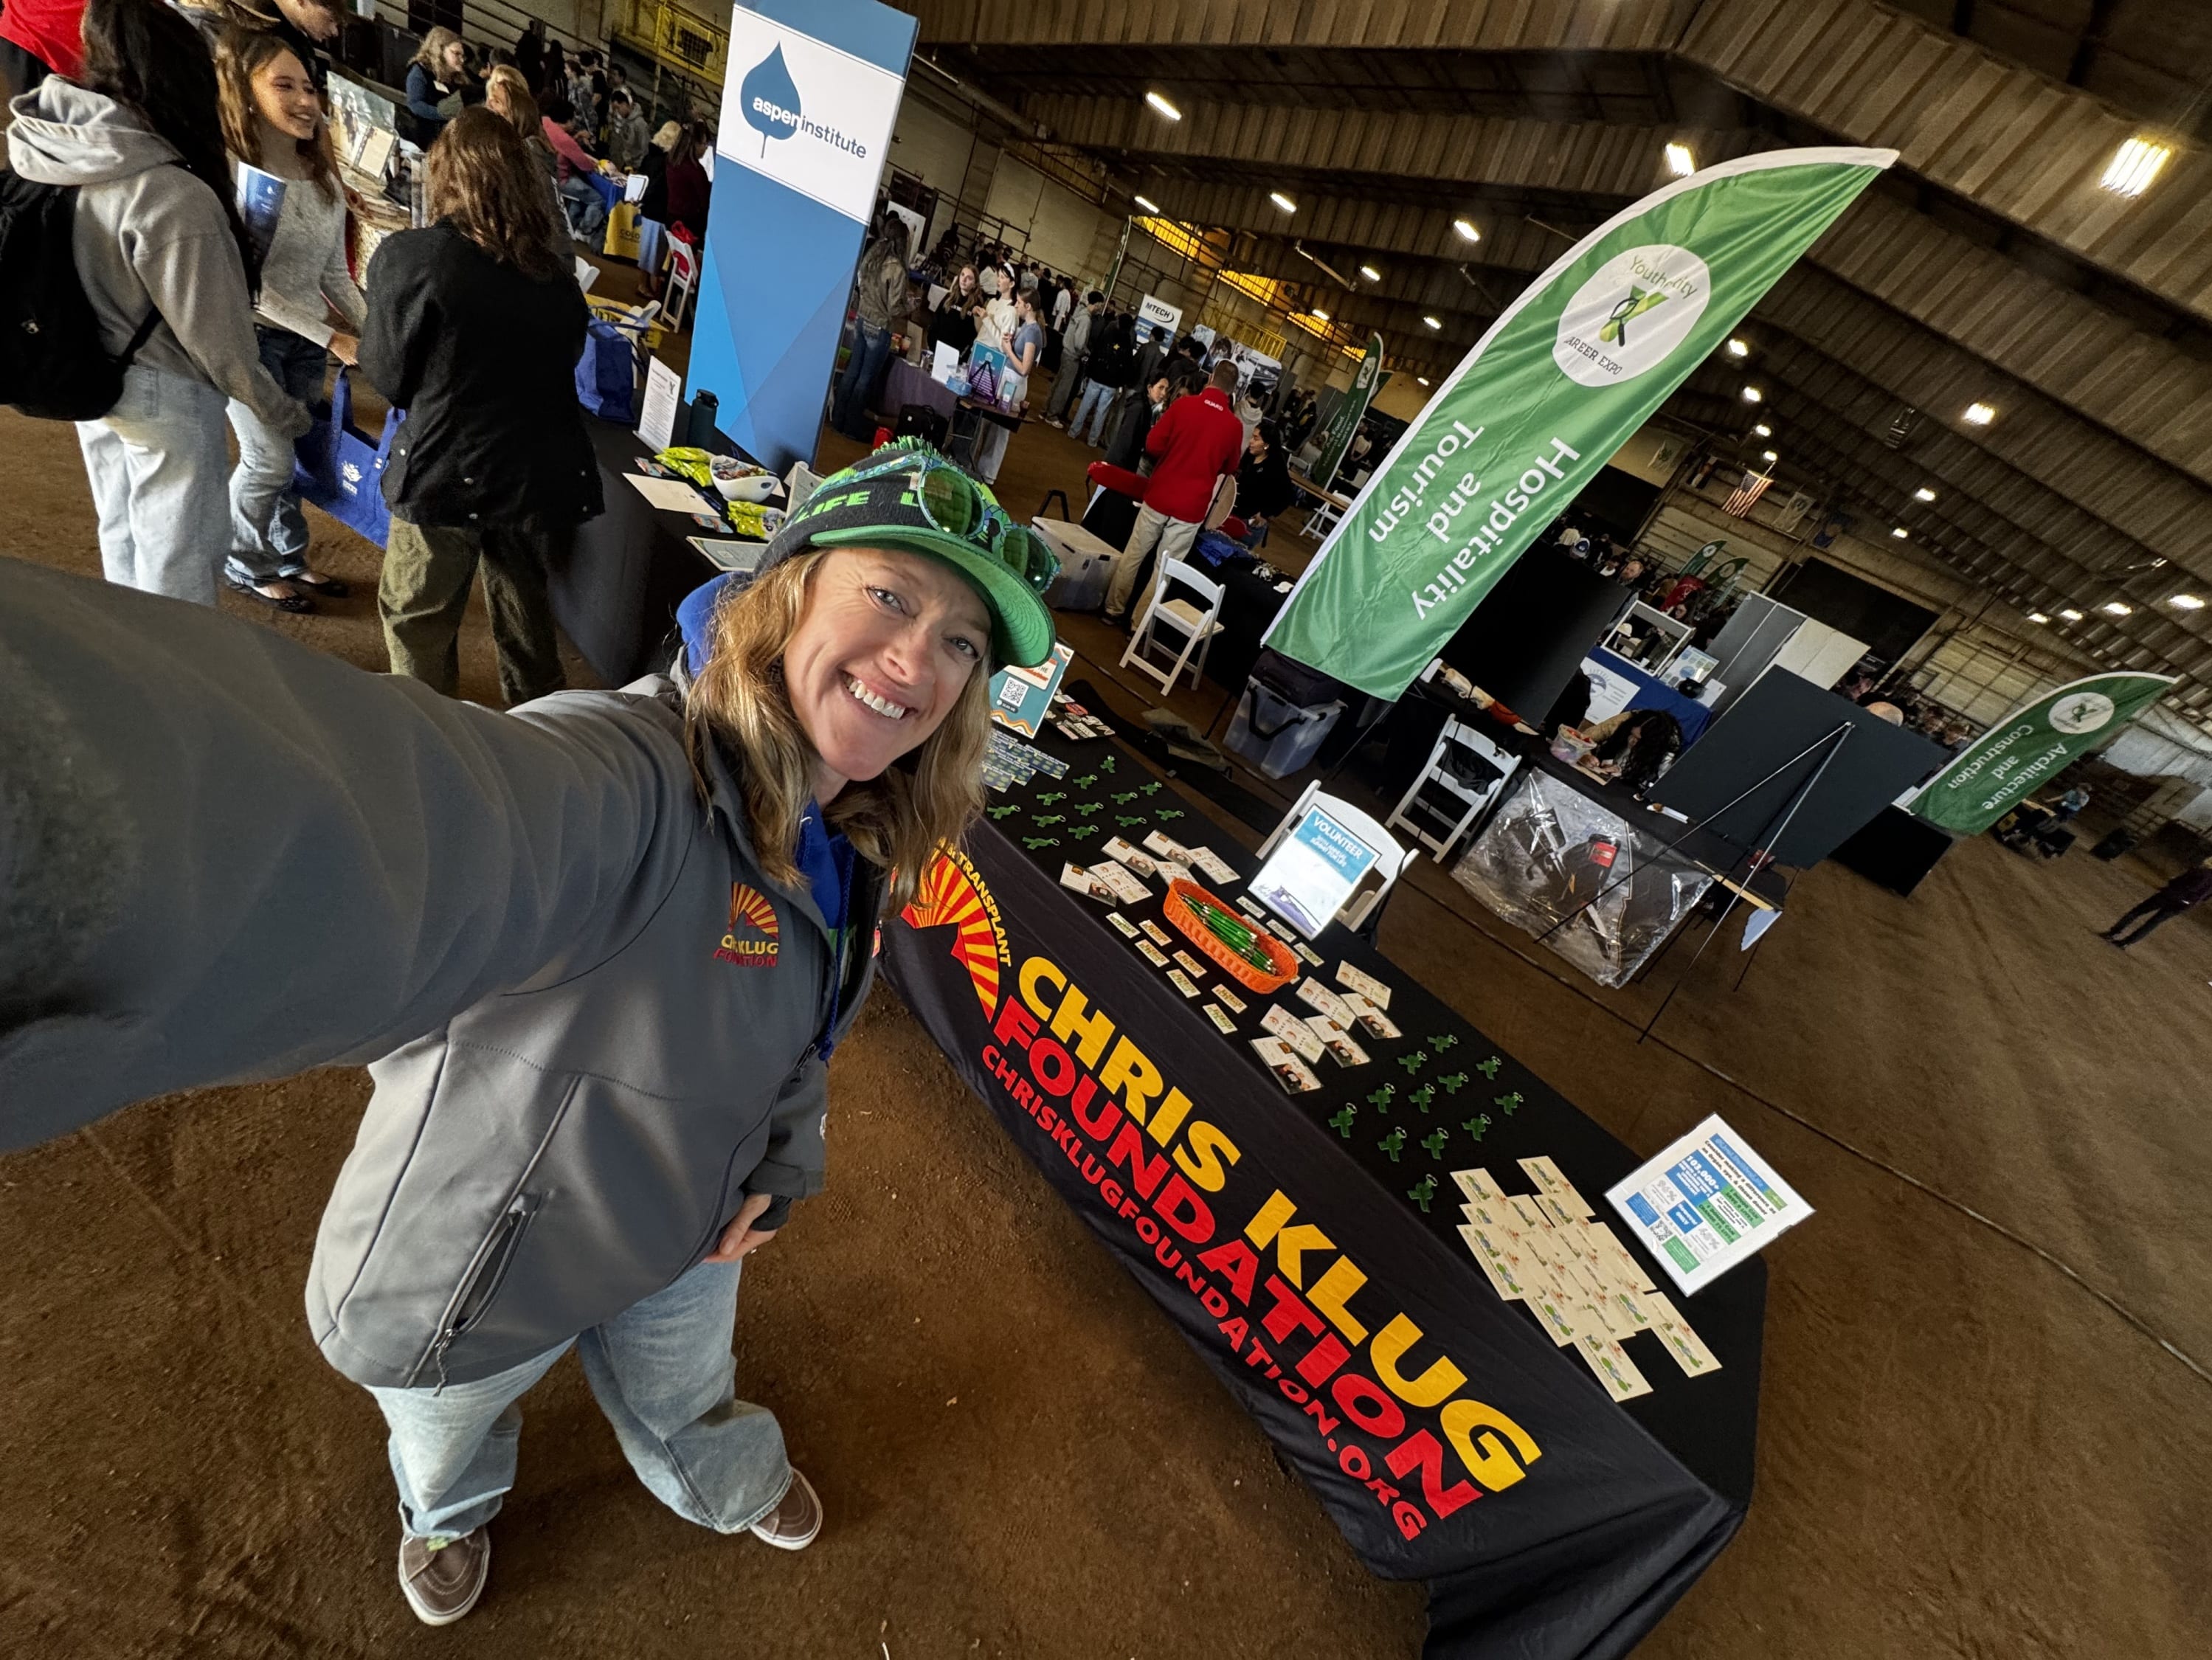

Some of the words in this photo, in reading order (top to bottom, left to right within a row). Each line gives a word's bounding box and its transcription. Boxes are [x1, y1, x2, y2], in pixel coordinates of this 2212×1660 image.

[753, 97, 801, 128] aspen
[801, 115, 867, 159] institute
[1145, 302, 1171, 319] MTECH
[1597, 356, 1623, 376] EXPO
[1368, 420, 1485, 542] Tourism
[1425, 472, 1482, 544] and
[1411, 436, 1581, 620] Hospitality
[1946, 724, 2034, 789] Construction
[1982, 741, 2069, 811] Architecture
[1990, 755, 2020, 780] and
[1313, 815, 1364, 860] VOLUNTEER
[959, 851, 1012, 968] TRANSPLANT
[1687, 1155, 1719, 1190] 103,000+
[1704, 1140, 1725, 1161] Consider
[1722, 1160, 1742, 1178] making
[1744, 1182, 1770, 1207] difference
[1018, 957, 1241, 1193] CHRIS
[1245, 1189, 1542, 1493] KLUG
[1752, 1199, 1768, 1215] donor
[993, 995, 1484, 1520] FOUNDATION
[982, 1045, 1428, 1541] CHRISKLUGFOUNDATION.ORG
